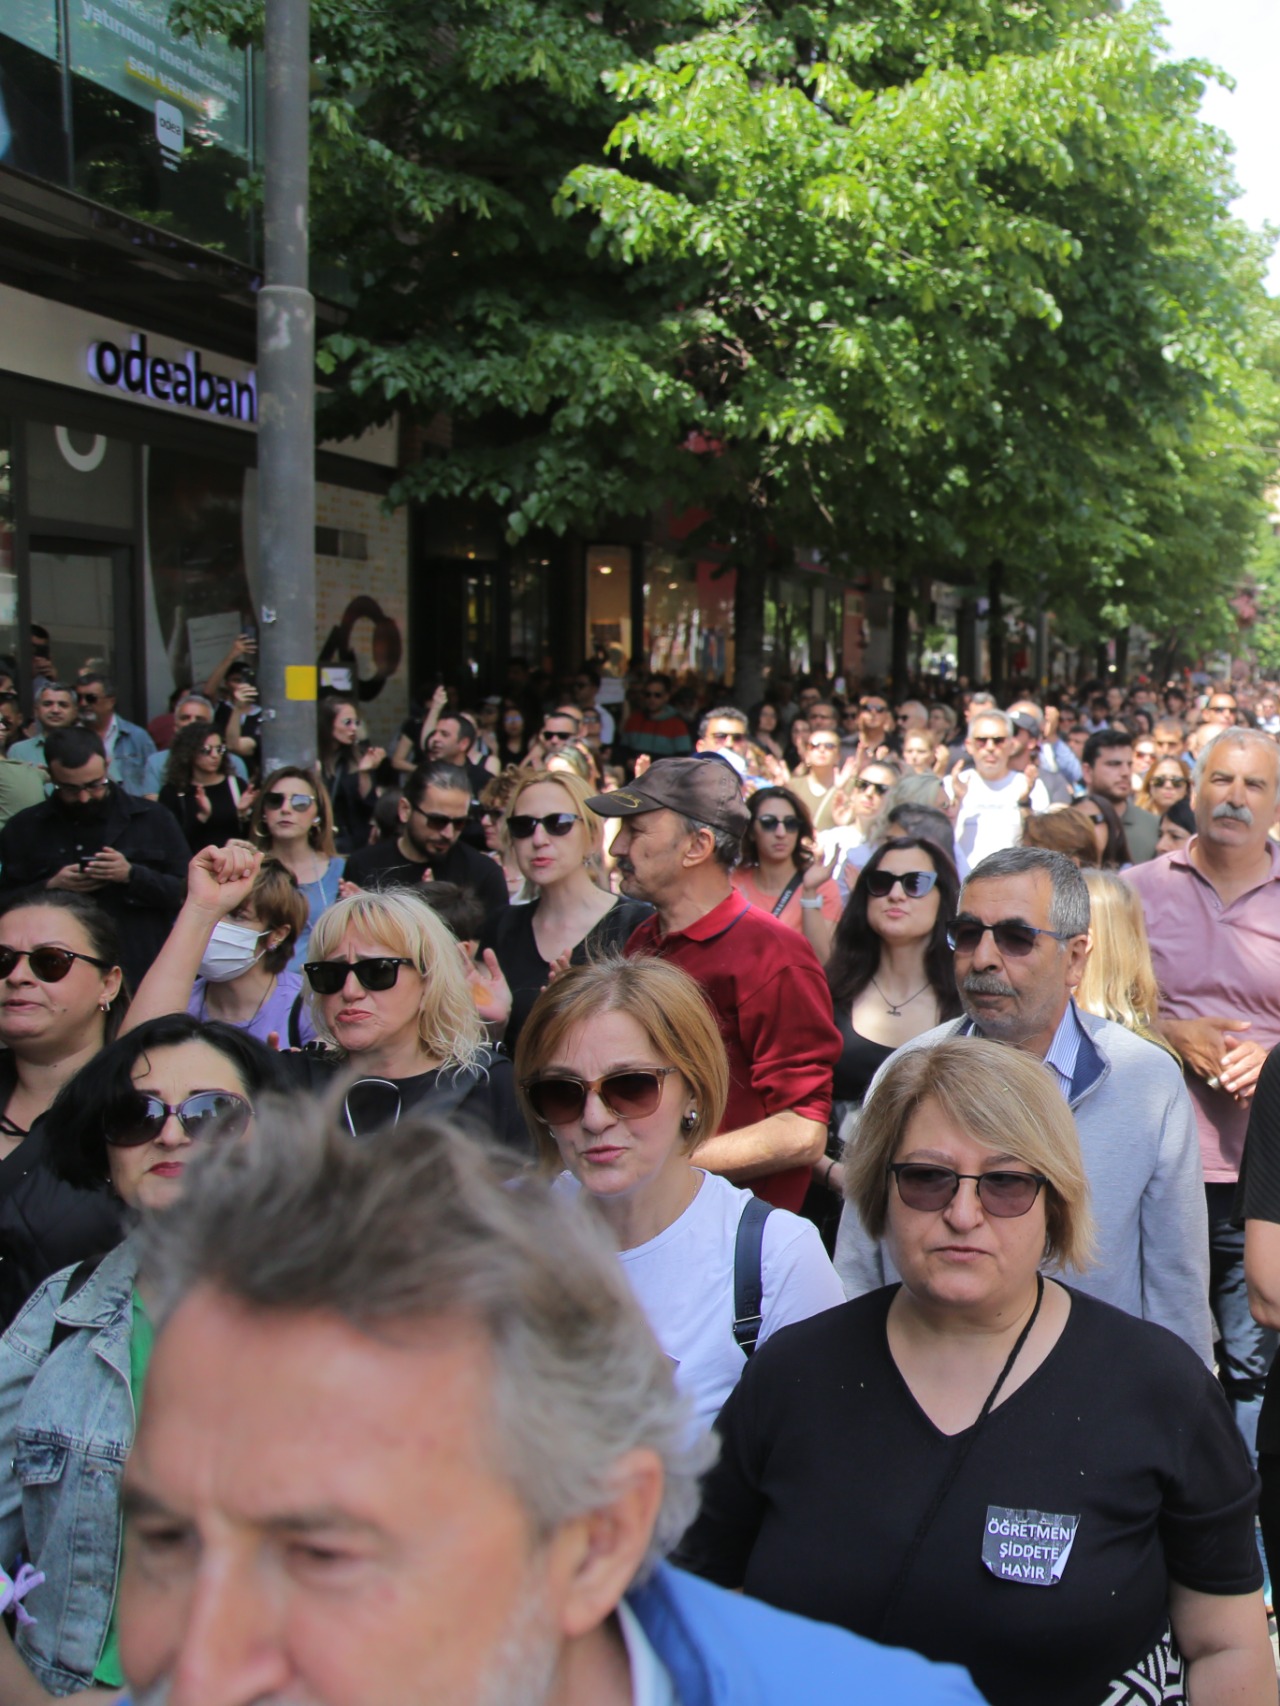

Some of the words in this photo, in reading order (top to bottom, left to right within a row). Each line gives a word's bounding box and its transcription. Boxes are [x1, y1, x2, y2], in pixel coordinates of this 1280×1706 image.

[159, 117, 182, 136] odea
[91, 331, 257, 423] odeaban
[999, 1540, 1060, 1561] ŞİDDETE
[1001, 1561, 1045, 1580] HAYIR
